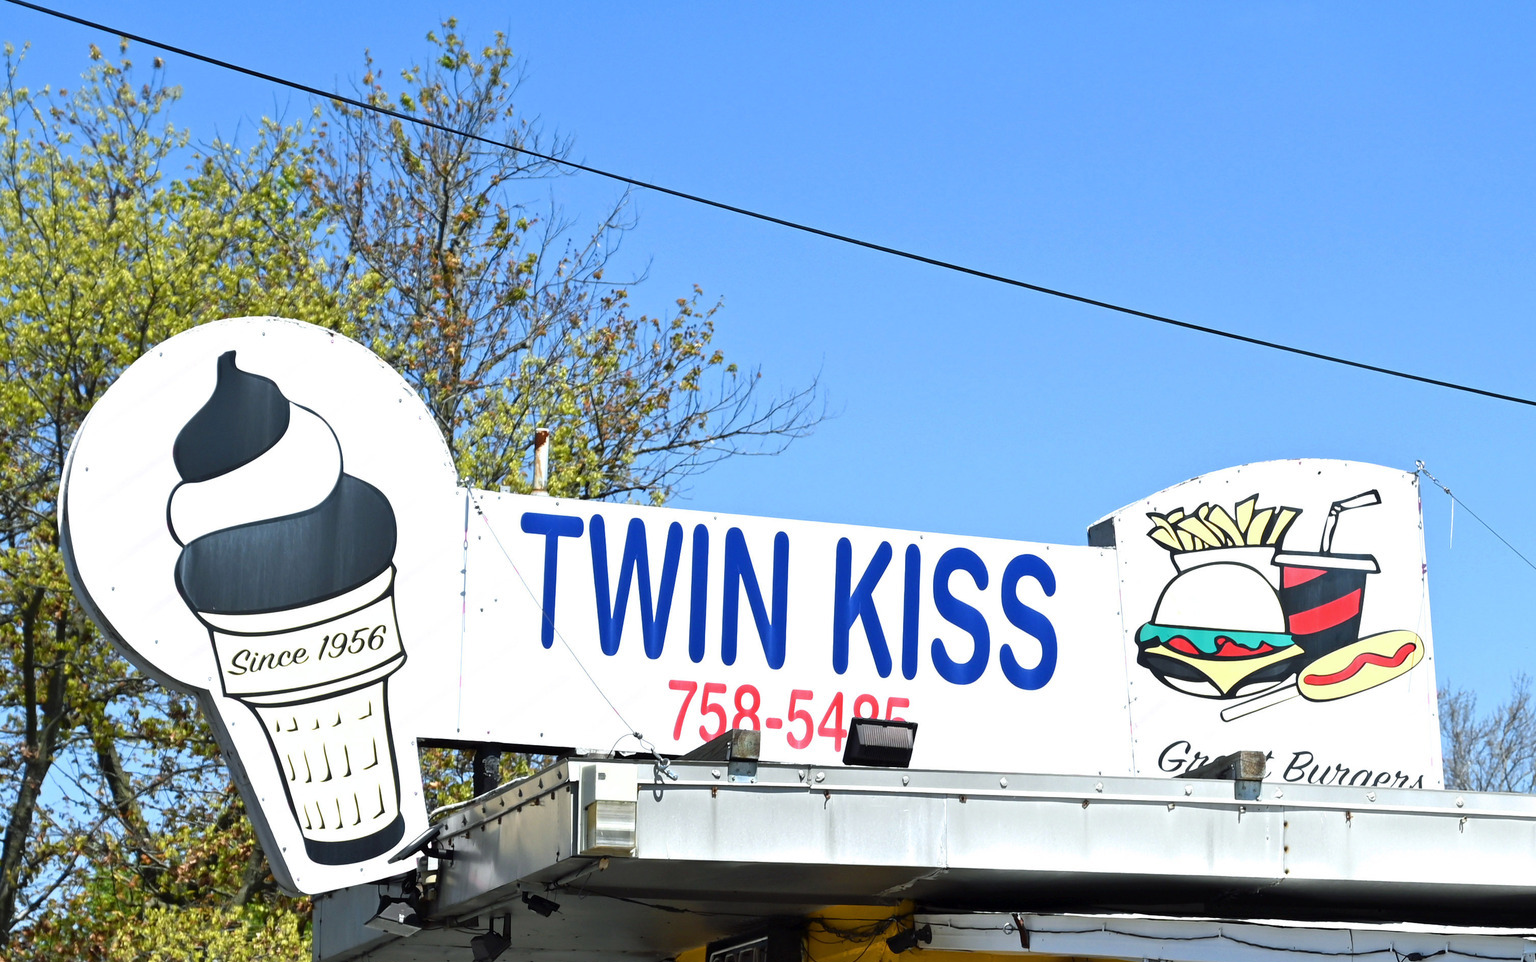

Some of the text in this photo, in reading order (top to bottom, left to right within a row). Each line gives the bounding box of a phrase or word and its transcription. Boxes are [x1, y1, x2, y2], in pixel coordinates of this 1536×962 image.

[228, 625, 388, 677] Since 1956
[520, 512, 1058, 691] TWIN KISS
